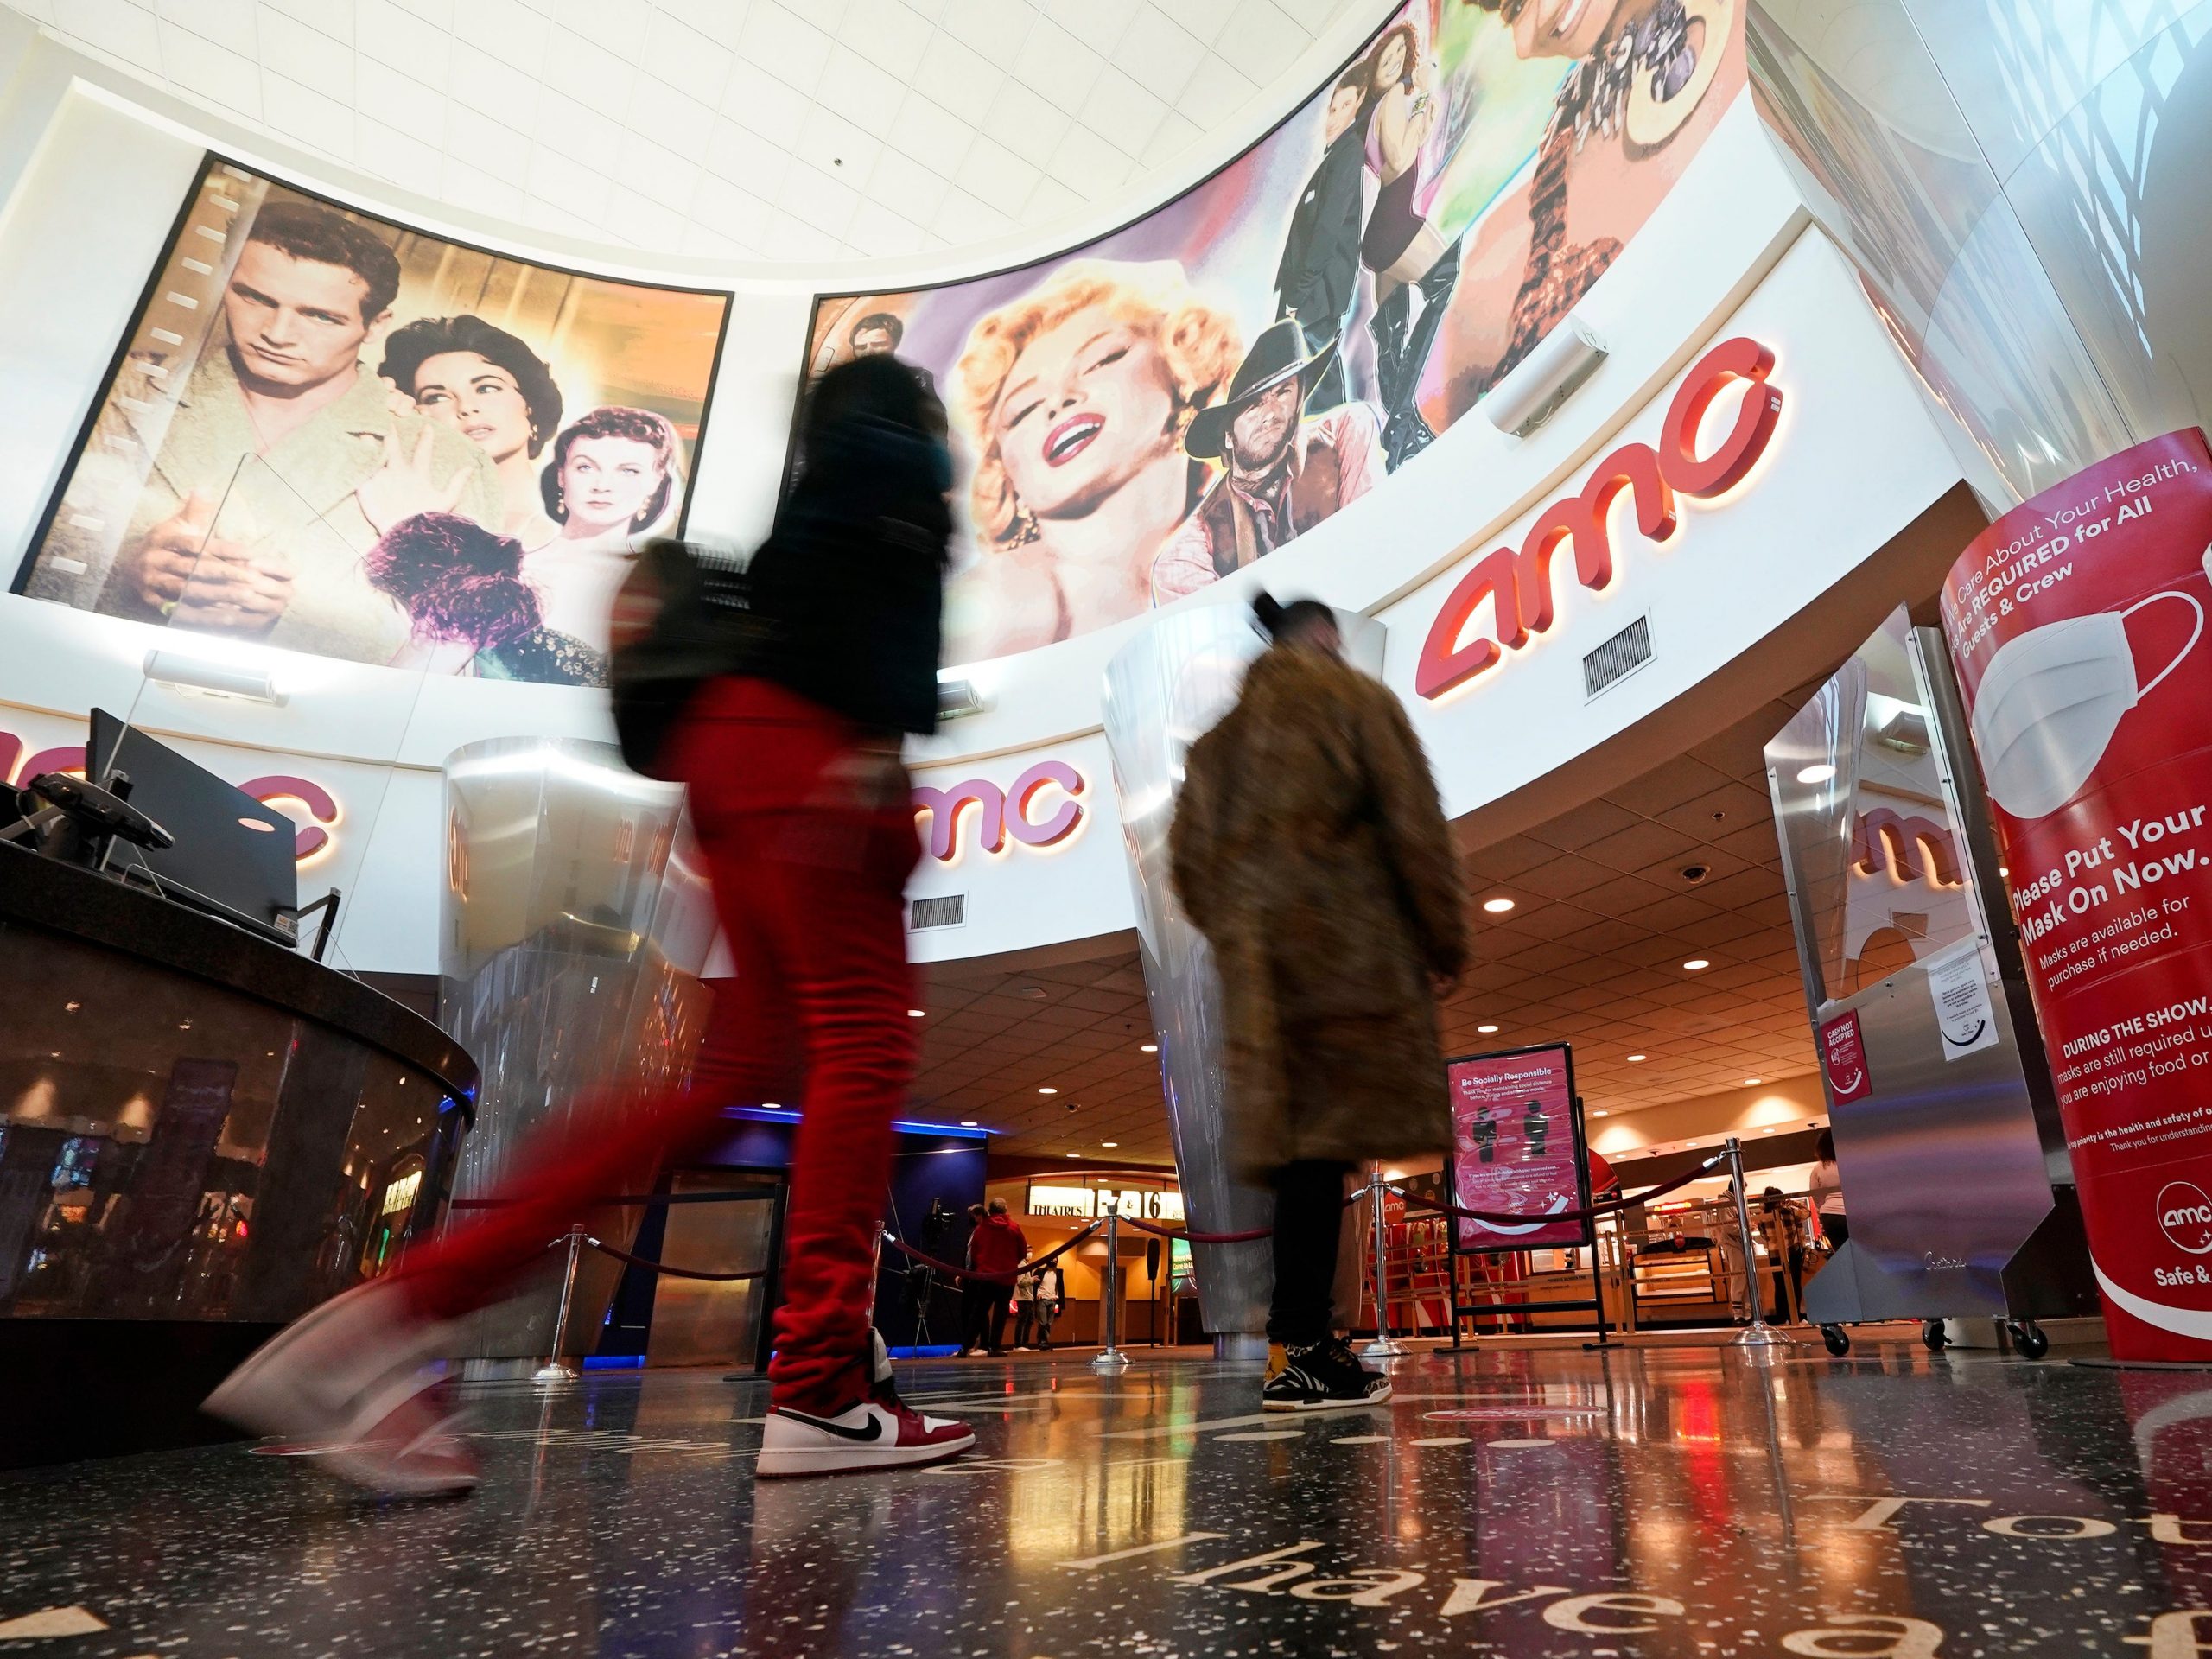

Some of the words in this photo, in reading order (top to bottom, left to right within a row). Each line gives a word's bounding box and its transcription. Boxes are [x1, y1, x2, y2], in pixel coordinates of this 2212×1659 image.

[1415, 337, 1783, 701] amc
[1957, 570, 1984, 604] Care
[1986, 524, 2044, 575] About
[2045, 496, 2099, 531] Your
[2104, 459, 2198, 503] Health,
[1957, 611, 1973, 640] Are
[1972, 536, 2069, 616] REQUIRED
[2075, 517, 2111, 543] for
[2117, 495, 2152, 525] All
[1962, 612, 1999, 659] Guests
[1999, 597, 2014, 616] &
[2015, 562, 2073, 603] Crew
[2012, 868, 2063, 917] Please
[2064, 837, 2115, 879] Put
[2117, 804, 2207, 850] Your
[2021, 900, 2068, 947] Mask
[2068, 883, 2109, 914] On
[2112, 848, 2210, 895] Now.
[2038, 946, 2068, 971] Masks
[2070, 936, 2089, 954] are
[2092, 907, 2158, 943] available
[2162, 895, 2190, 915] for
[2048, 958, 2096, 992] purchase
[2097, 948, 2107, 964] if
[2111, 922, 2178, 959] needed.
[1827, 1027, 1841, 1039] CASH
[1840, 1020, 1853, 1031] NOT
[1828, 1029, 1855, 1047] ACCEPTED
[2056, 1066, 2082, 1085] masks
[2082, 1059, 2101, 1075] are
[2103, 1046, 2126, 1067] still
[2128, 1025, 2196, 1060] required
[2063, 1028, 2111, 1059] DURING
[2111, 1016, 2145, 1039] THE
[1461, 1078, 1471, 1087] Be
[1472, 1074, 1503, 1084] Socially
[1504, 1067, 1552, 1081] Responsible
[2060, 1092, 2074, 1110] you
[2074, 1085, 2089, 1102] are
[2091, 1068, 2147, 1096] enjoying
[2149, 1052, 2187, 1077] food
[2190, 1050, 2209, 1066] or
[2097, 1131, 2104, 1141] is
[2104, 1128, 2118, 1139] the
[2118, 1122, 2144, 1135] health
[2145, 1116, 2162, 1128] and
[2162, 1110, 2191, 1125] safety
[2192, 1106, 2202, 1118] of
[2110, 1141, 2133, 1153] Thank
[2133, 1139, 2147, 1150] you
[2147, 1135, 2158, 1144] for
[1033, 1204, 1083, 1217] THEATRES
[1139, 1192, 1161, 1219] 16
[2154, 1266, 2195, 1287] Safe
[2196, 1264, 2211, 1284] &
[1165, 1541, 1687, 1636] have
